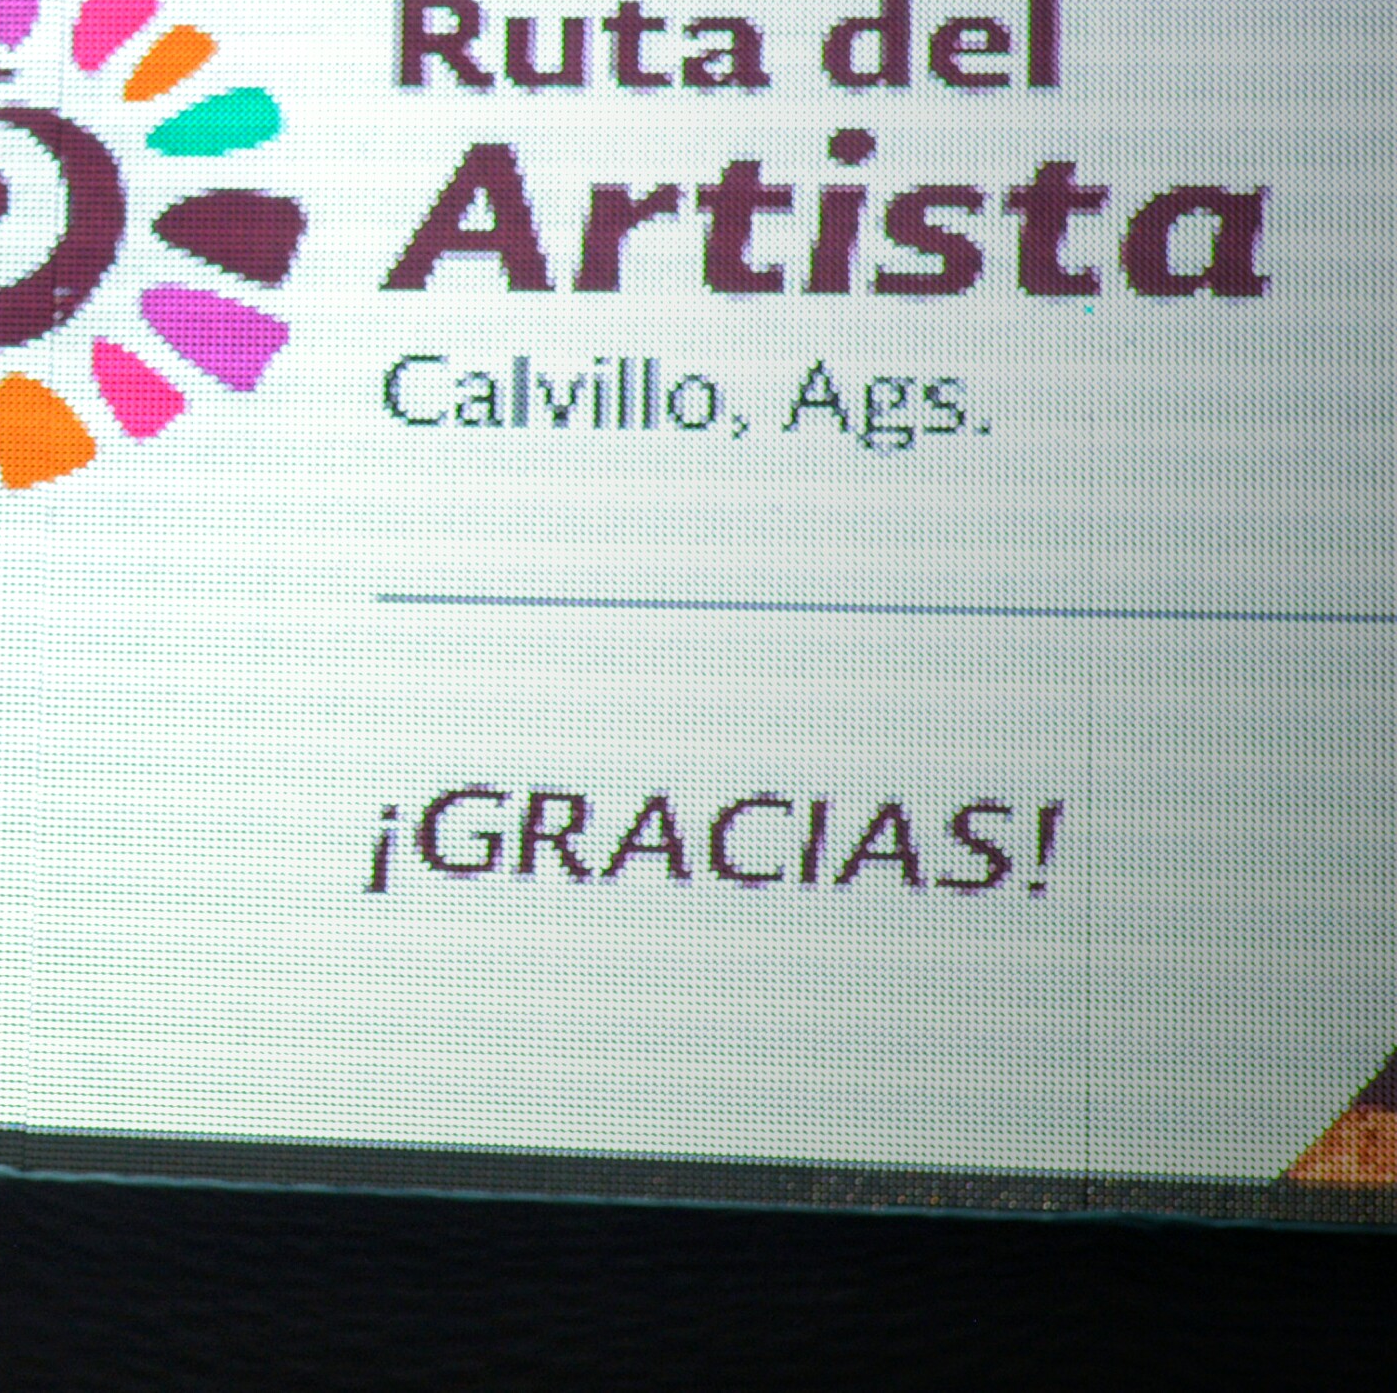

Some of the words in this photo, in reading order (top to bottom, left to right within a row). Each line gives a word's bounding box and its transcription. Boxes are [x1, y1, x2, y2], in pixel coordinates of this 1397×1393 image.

[380, 127, 1272, 299] Artista
[382, 353, 751, 439] Calvillo,
[782, 359, 993, 452] Ags.
[362, 784, 1065, 897] ¡GRACIAS!
